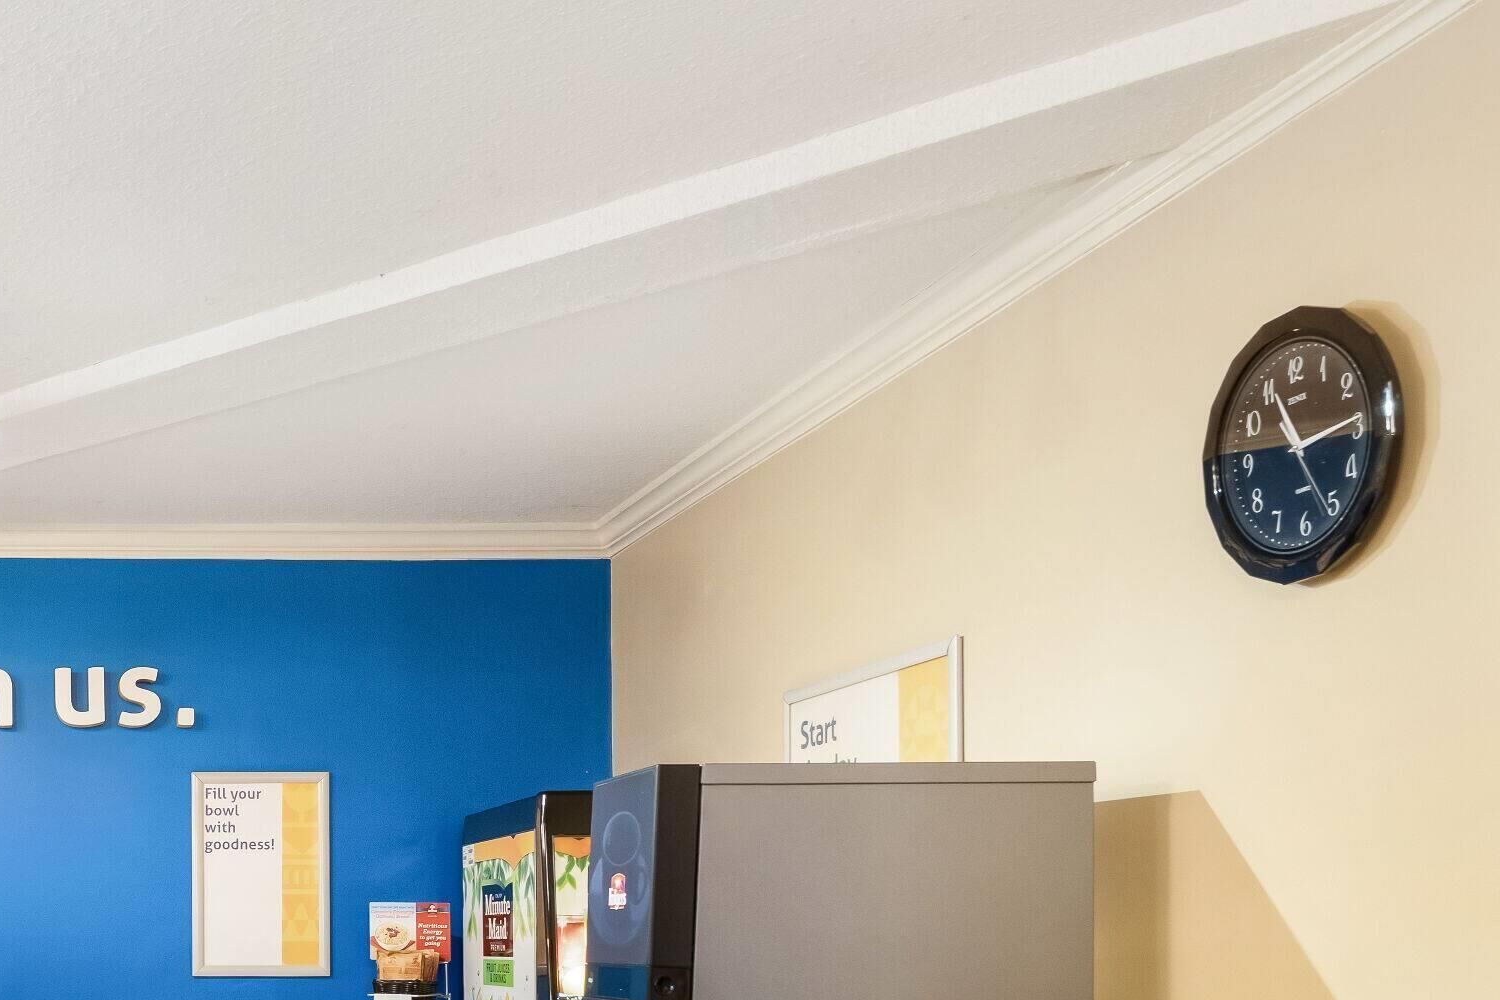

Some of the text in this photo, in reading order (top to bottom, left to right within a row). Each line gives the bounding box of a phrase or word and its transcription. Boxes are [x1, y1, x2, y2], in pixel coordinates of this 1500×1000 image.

[1288, 356, 1304, 384] 12
[1319, 355, 1327, 382] 1
[1262, 378, 1275, 405] 11
[1340, 372, 1354, 400] 2
[1246, 410, 1261, 437] 10
[1351, 411, 1364, 439] 3
[1242, 453, 1254, 477] 9
[1345, 453, 1358, 479] 4
[1251, 487, 1264, 512] 8
[1326, 489, 1340, 516] 5
[1271, 510, 1282, 533] 7
[1299, 511, 1312, 536] 6
[54, 665, 196, 729] us.
[800, 716, 837, 750] Start
[205, 787, 262, 803] Fill your
[205, 804, 240, 816] bowl
[205, 821, 236, 833] with
[204, 838, 275, 853] goodness!
[485, 893, 511, 916] Minute
[422, 928, 443, 936] Energy
[488, 917, 508, 940] Maid
[424, 940, 441, 948] going
[490, 944, 506, 952] PREMIUM
